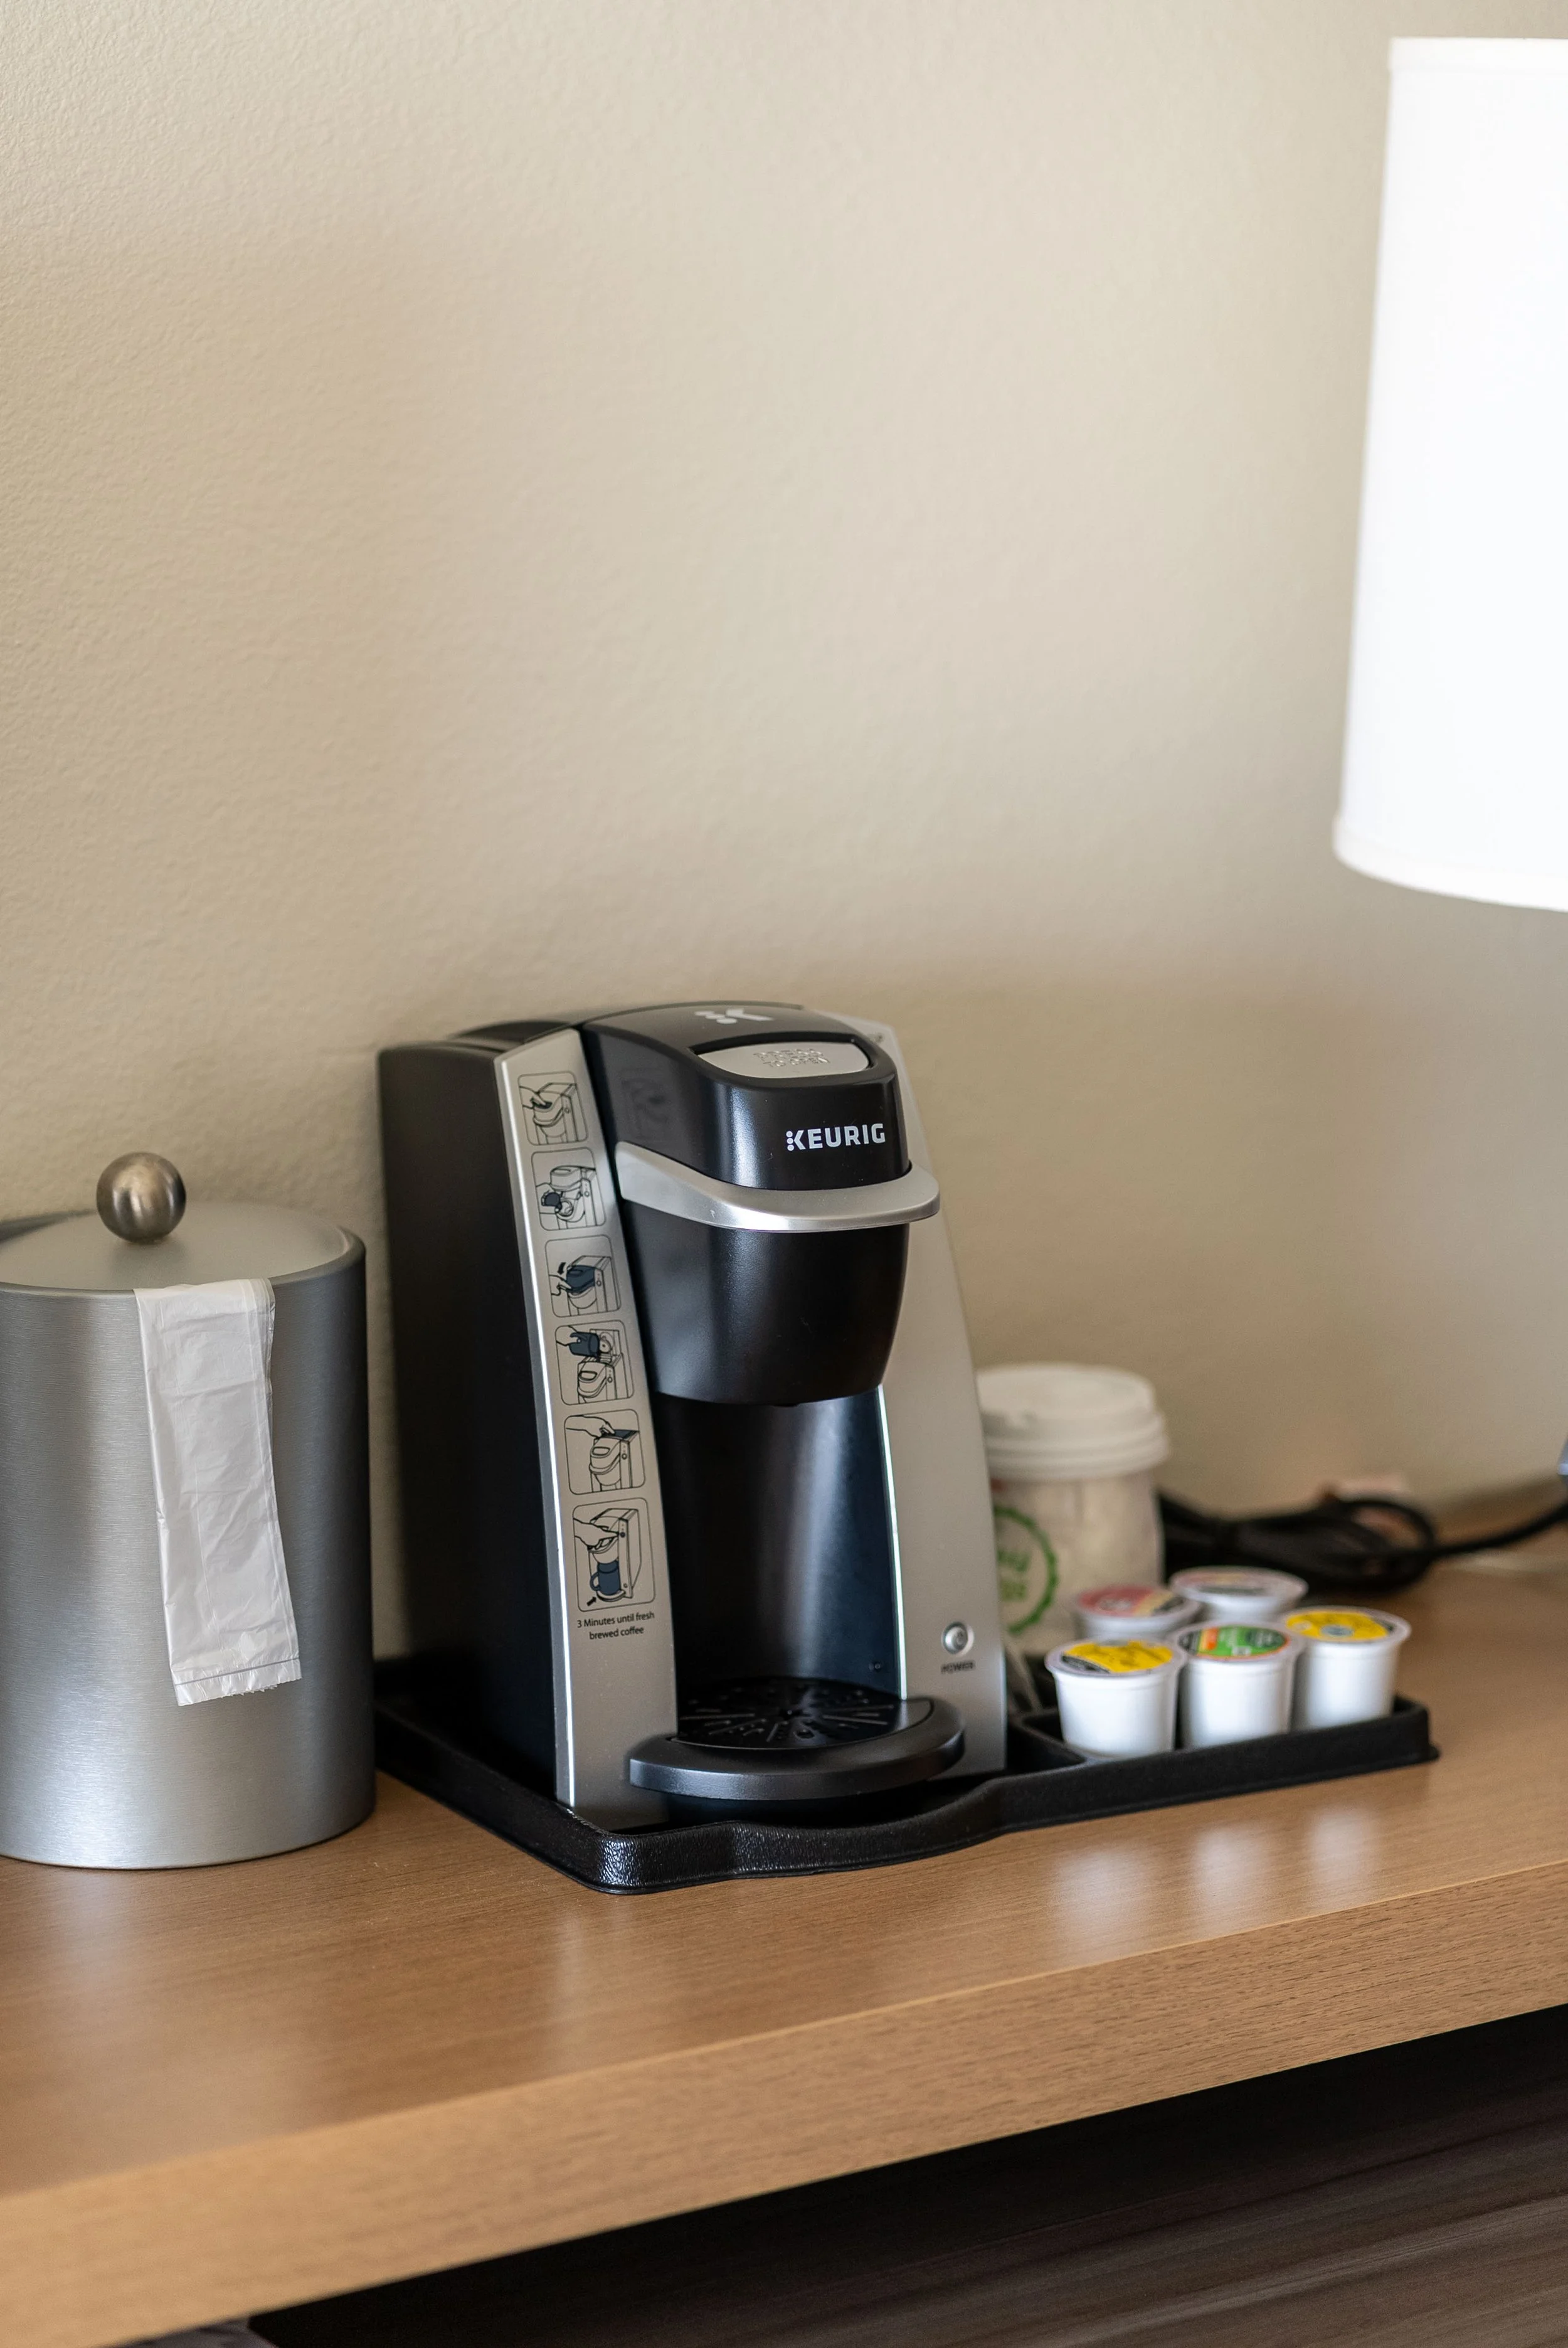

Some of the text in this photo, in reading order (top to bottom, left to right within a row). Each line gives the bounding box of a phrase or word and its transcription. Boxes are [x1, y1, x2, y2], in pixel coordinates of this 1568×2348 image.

[786, 1123, 886, 1152] KEURIG
[577, 1611, 655, 1628] 3 Minutes until fresh
[590, 1626, 644, 1640] brewed coffee
